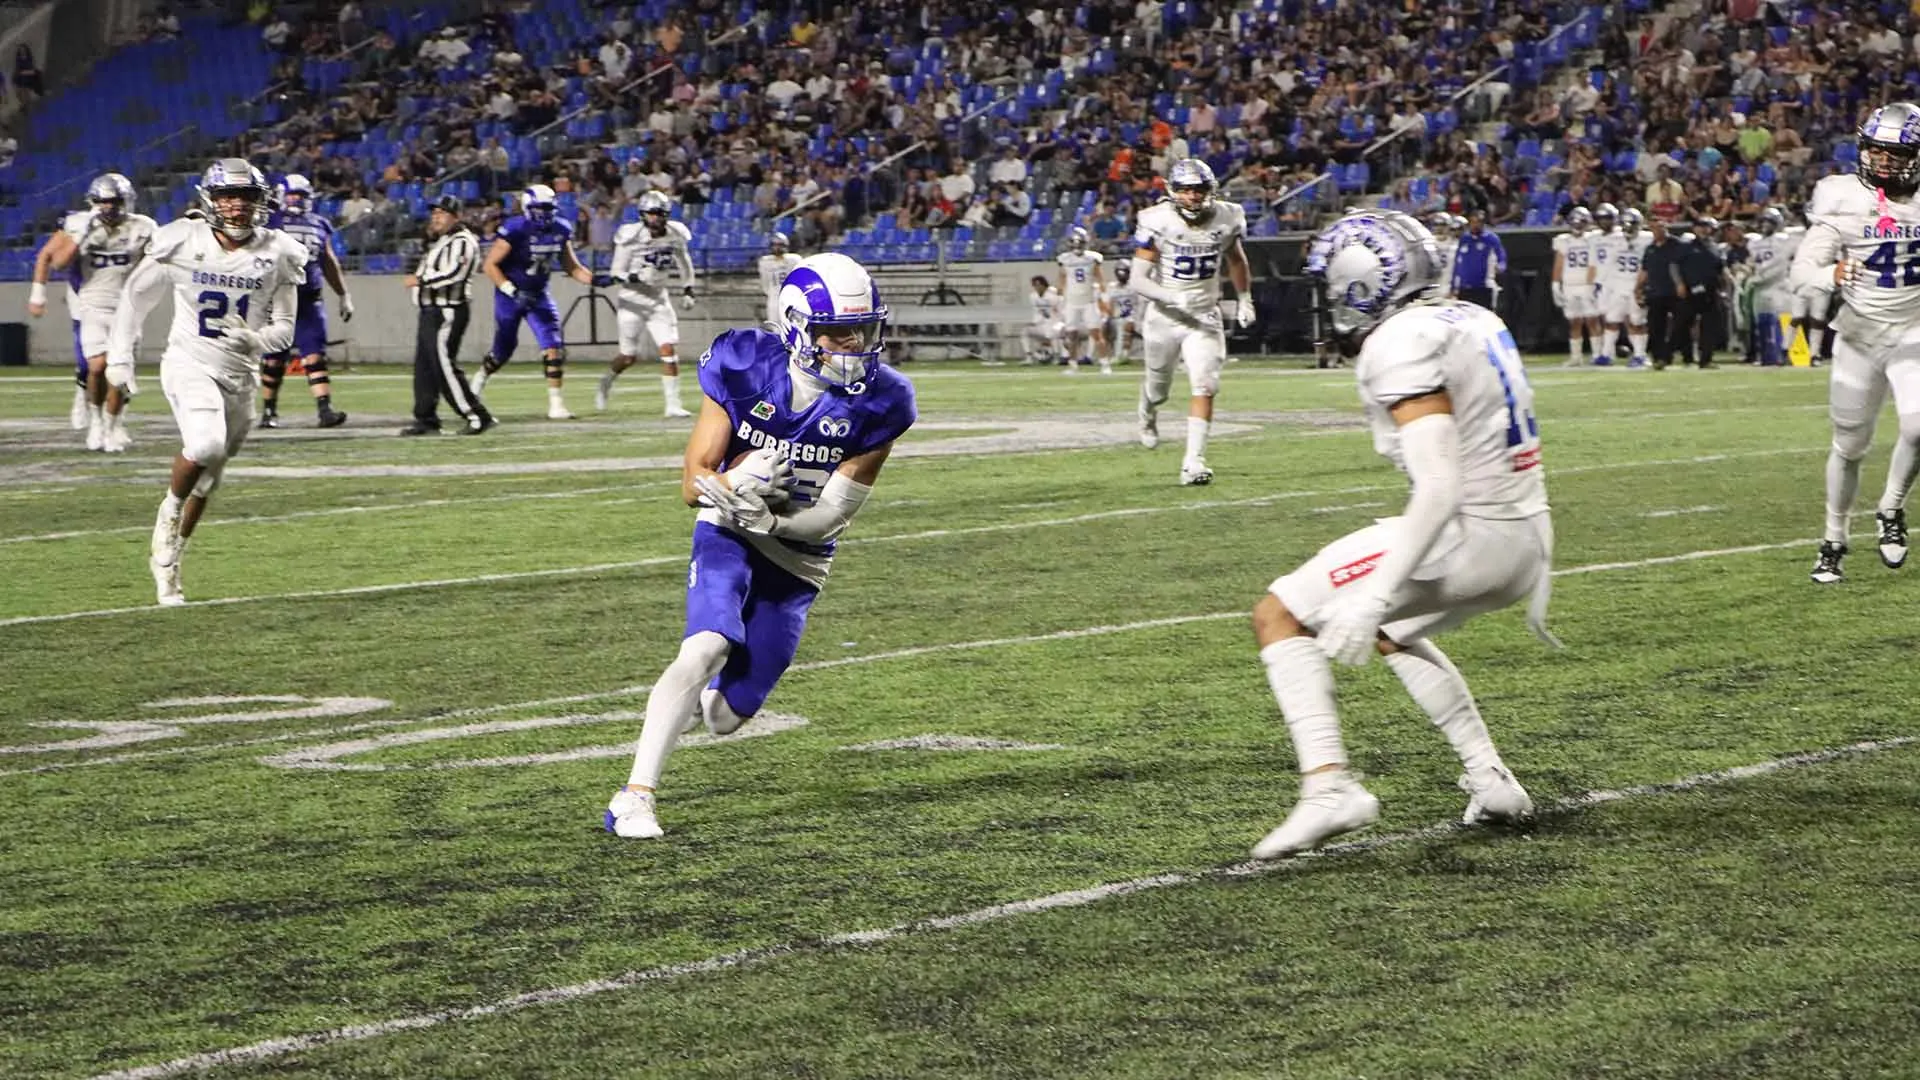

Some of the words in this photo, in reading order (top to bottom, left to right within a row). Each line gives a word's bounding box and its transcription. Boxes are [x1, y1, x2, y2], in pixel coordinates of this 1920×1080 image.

[192, 271, 264, 290] BORREGOS
[198, 290, 250, 339] 21
[737, 420, 844, 464] BORREGOS
